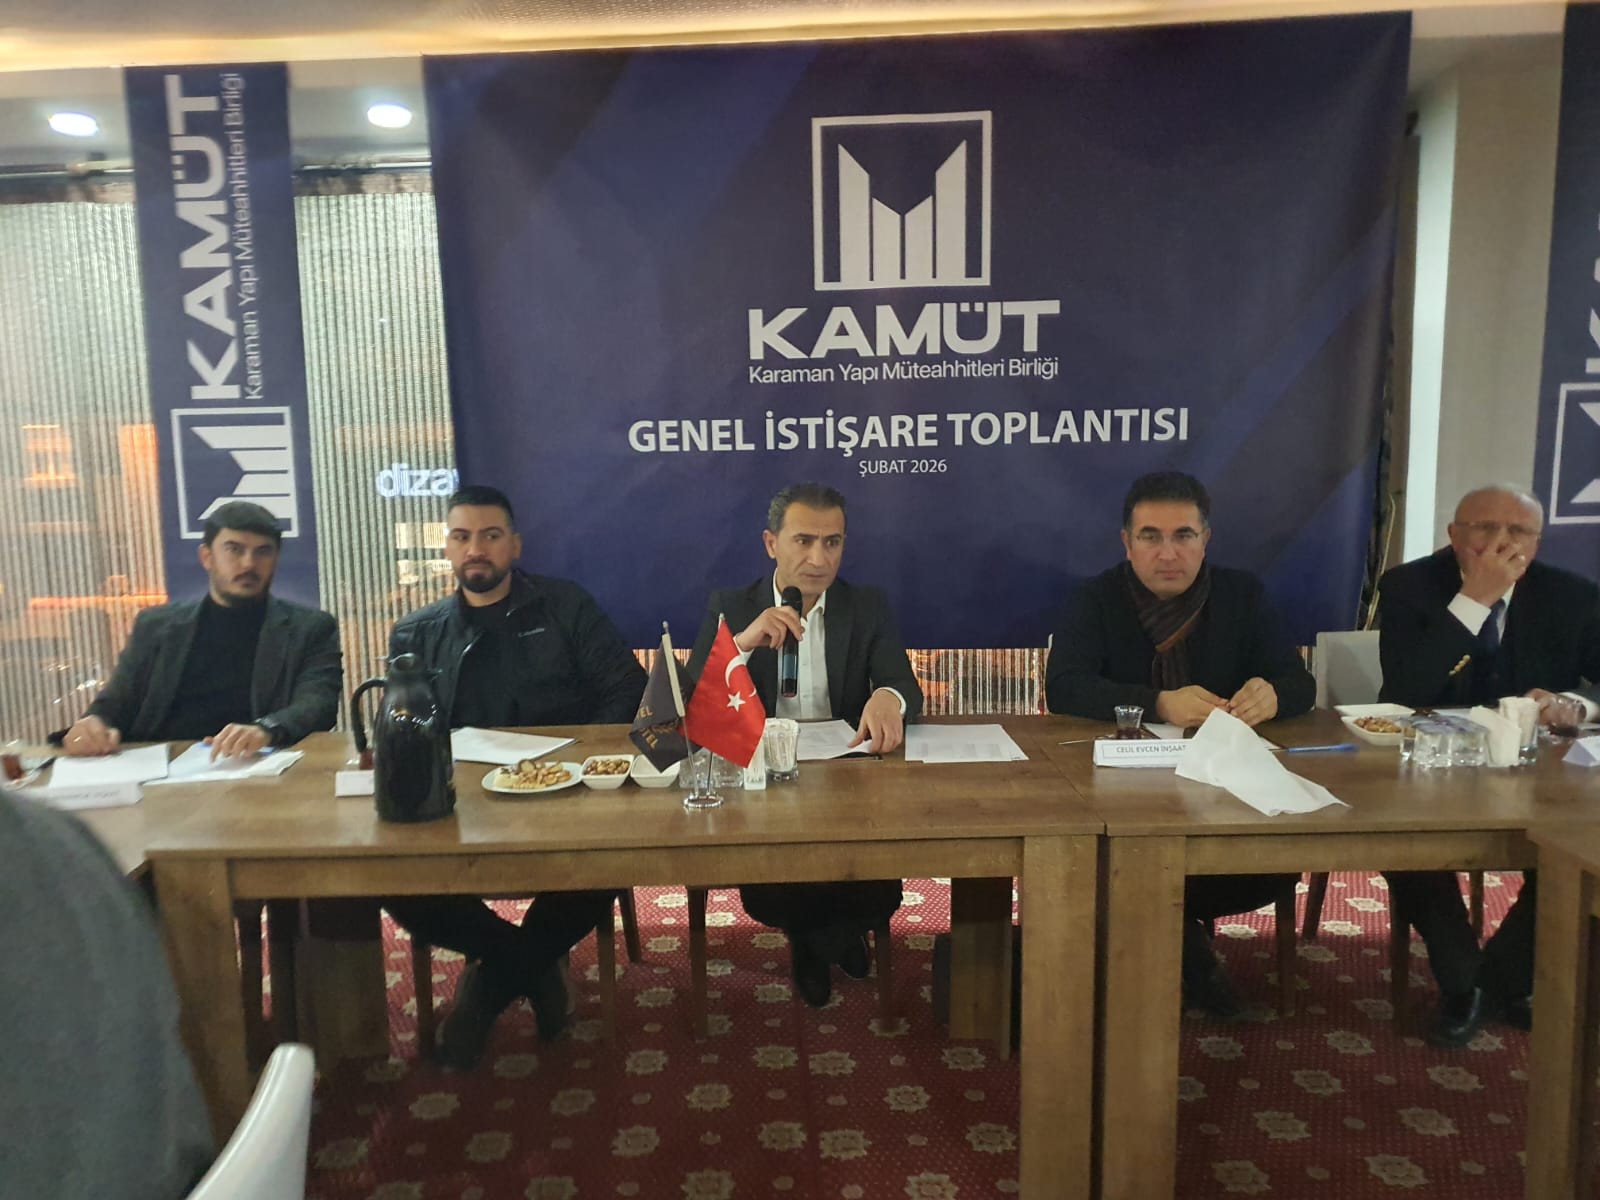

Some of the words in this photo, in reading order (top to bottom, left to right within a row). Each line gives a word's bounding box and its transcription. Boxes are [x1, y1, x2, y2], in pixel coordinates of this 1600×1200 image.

[221, 73, 246, 126] Birliği
[225, 131, 254, 260] Müteahhitleri
[165, 74, 242, 401] KAMÜT
[238, 265, 260, 307] Yapı
[244, 311, 263, 400] Karaman
[748, 300, 1060, 360] KAMÜT
[749, 365, 834, 384] Karaman
[839, 362, 879, 384] Yapı
[882, 357, 1004, 380] Müteahhitleri
[1009, 356, 1059, 379] Birliği
[628, 419, 755, 453] GENEL
[765, 409, 938, 457] İSTİŞARE
[947, 407, 1189, 446] TOPLANTISI
[858, 459, 907, 478] ŞUBAT
[910, 459, 947, 474] 2026
